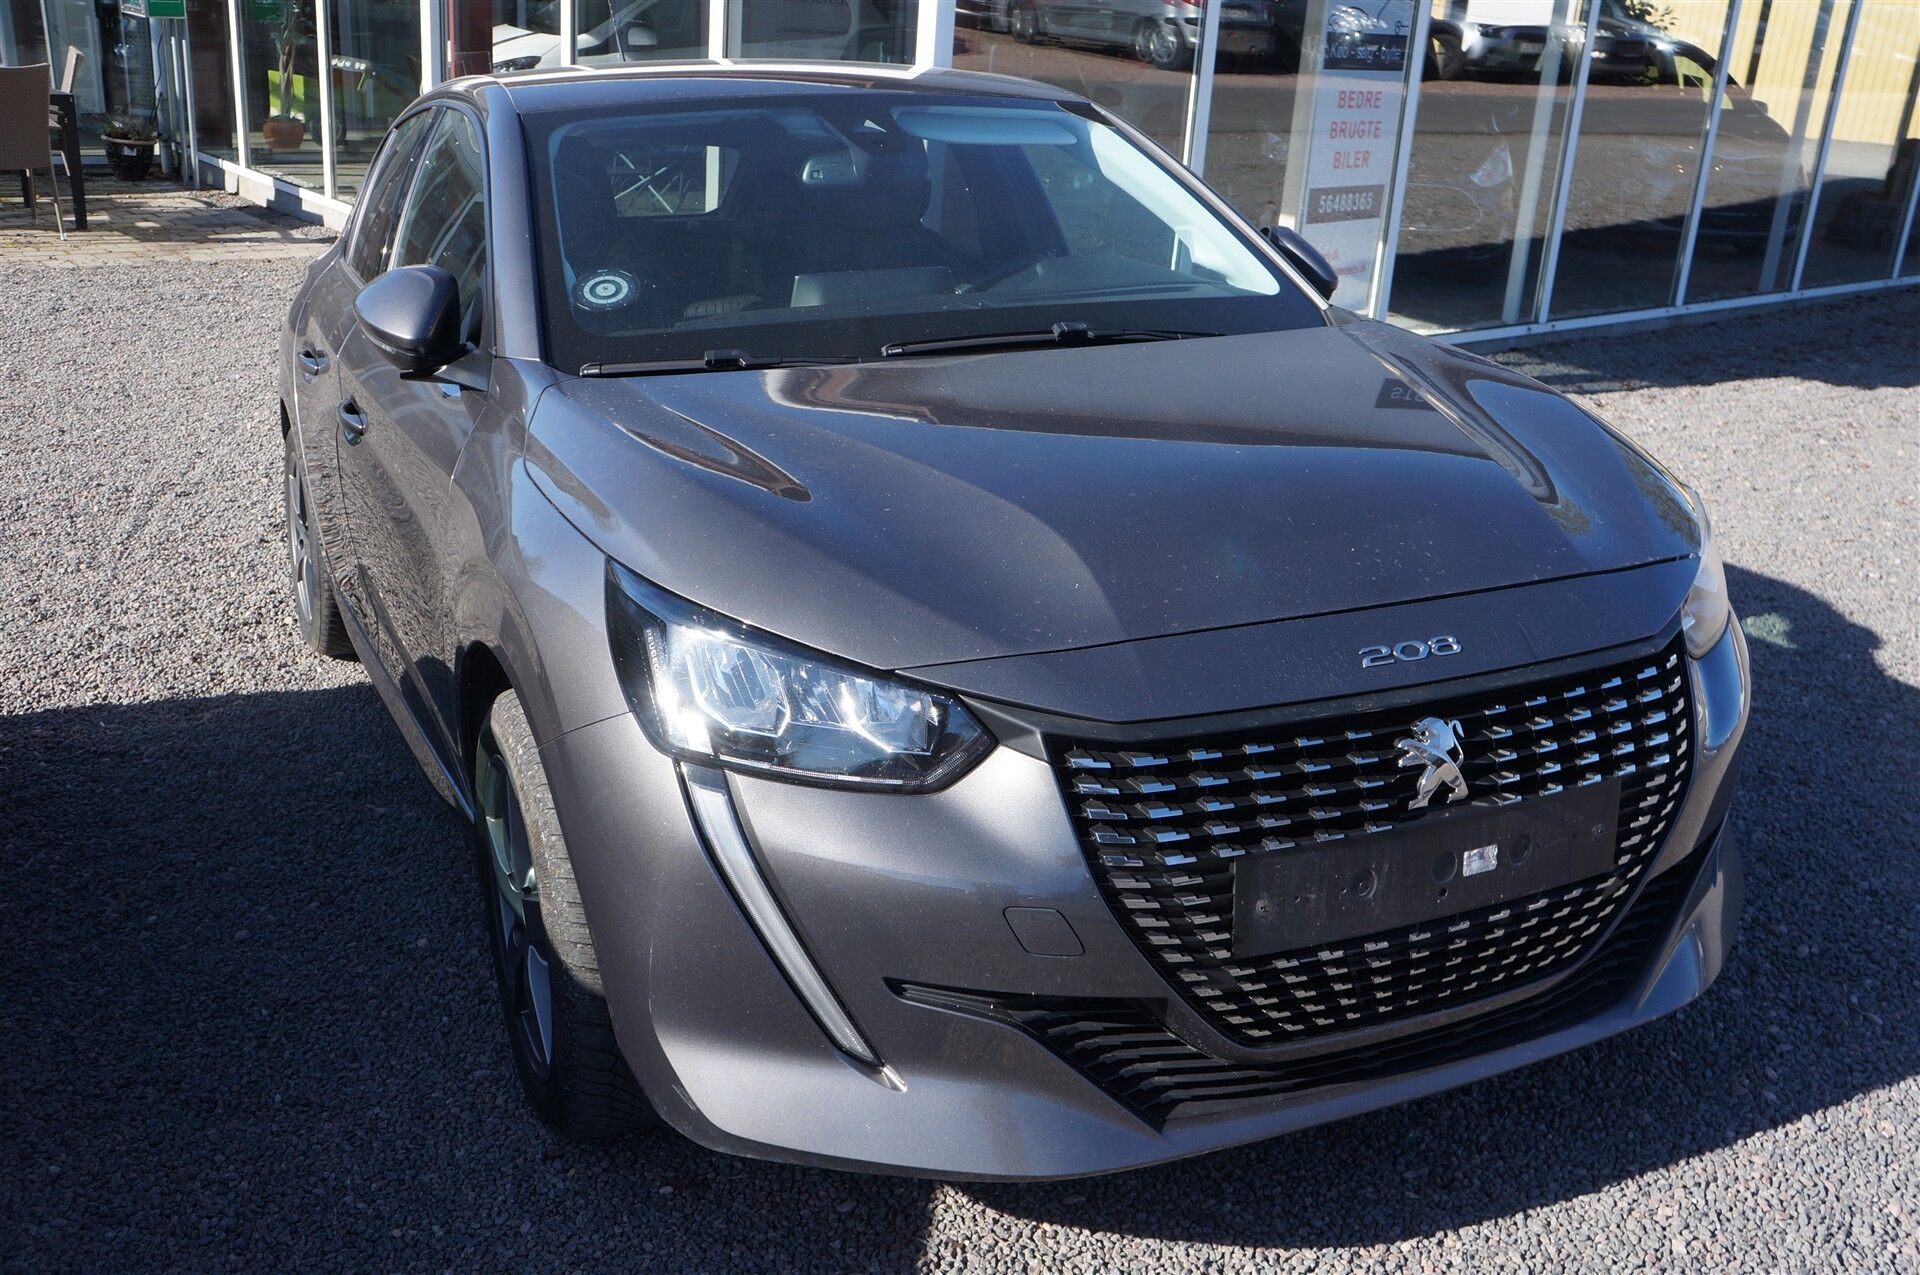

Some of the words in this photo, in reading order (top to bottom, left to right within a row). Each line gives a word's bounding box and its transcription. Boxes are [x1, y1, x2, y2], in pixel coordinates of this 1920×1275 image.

[1338, 90, 1382, 109] BEDRE
[1329, 121, 1382, 139] BRUGTE
[1333, 150, 1371, 169] BILER
[1318, 192, 1374, 213] 56488365
[646, 629, 661, 676] PEUGEO
[1359, 635, 1462, 668] 208
